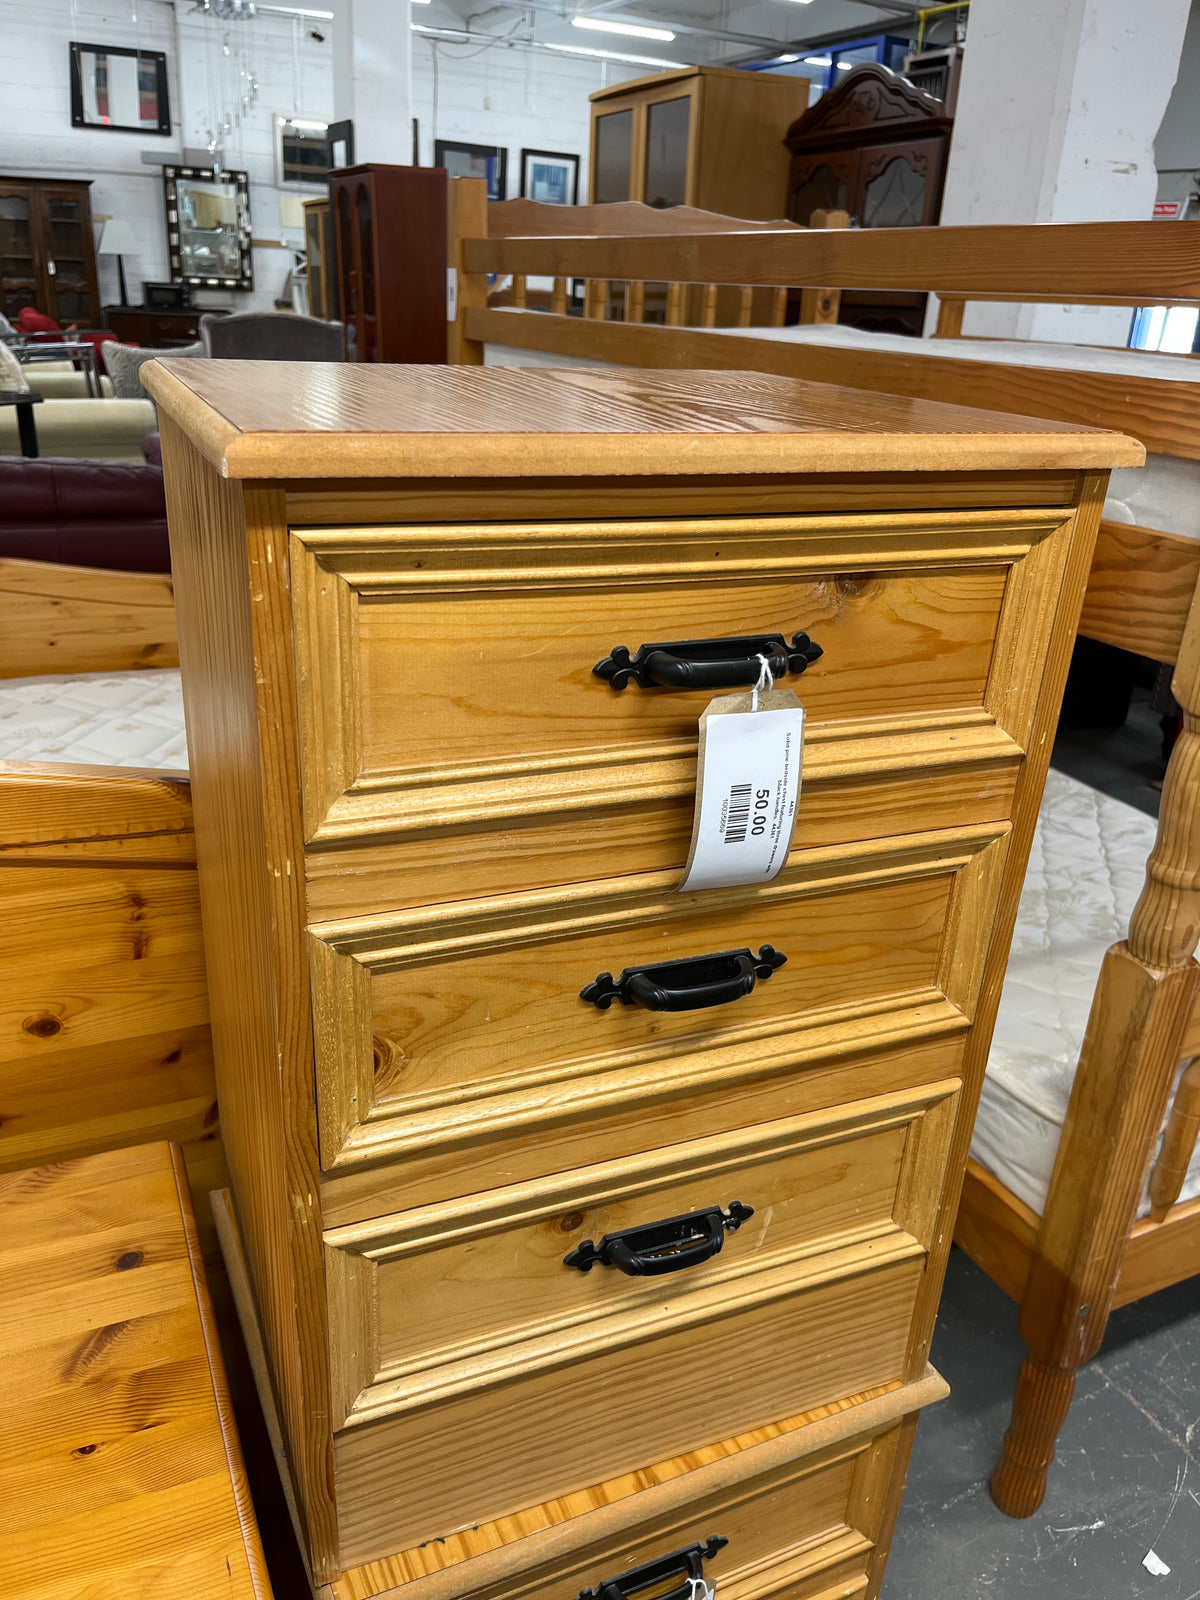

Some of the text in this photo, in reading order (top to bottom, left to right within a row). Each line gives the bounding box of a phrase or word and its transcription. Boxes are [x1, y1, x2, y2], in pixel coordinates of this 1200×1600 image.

[751, 789, 770, 836] 50.00
[776, 804, 786, 829] featuring
[768, 844, 778, 864] drawers
